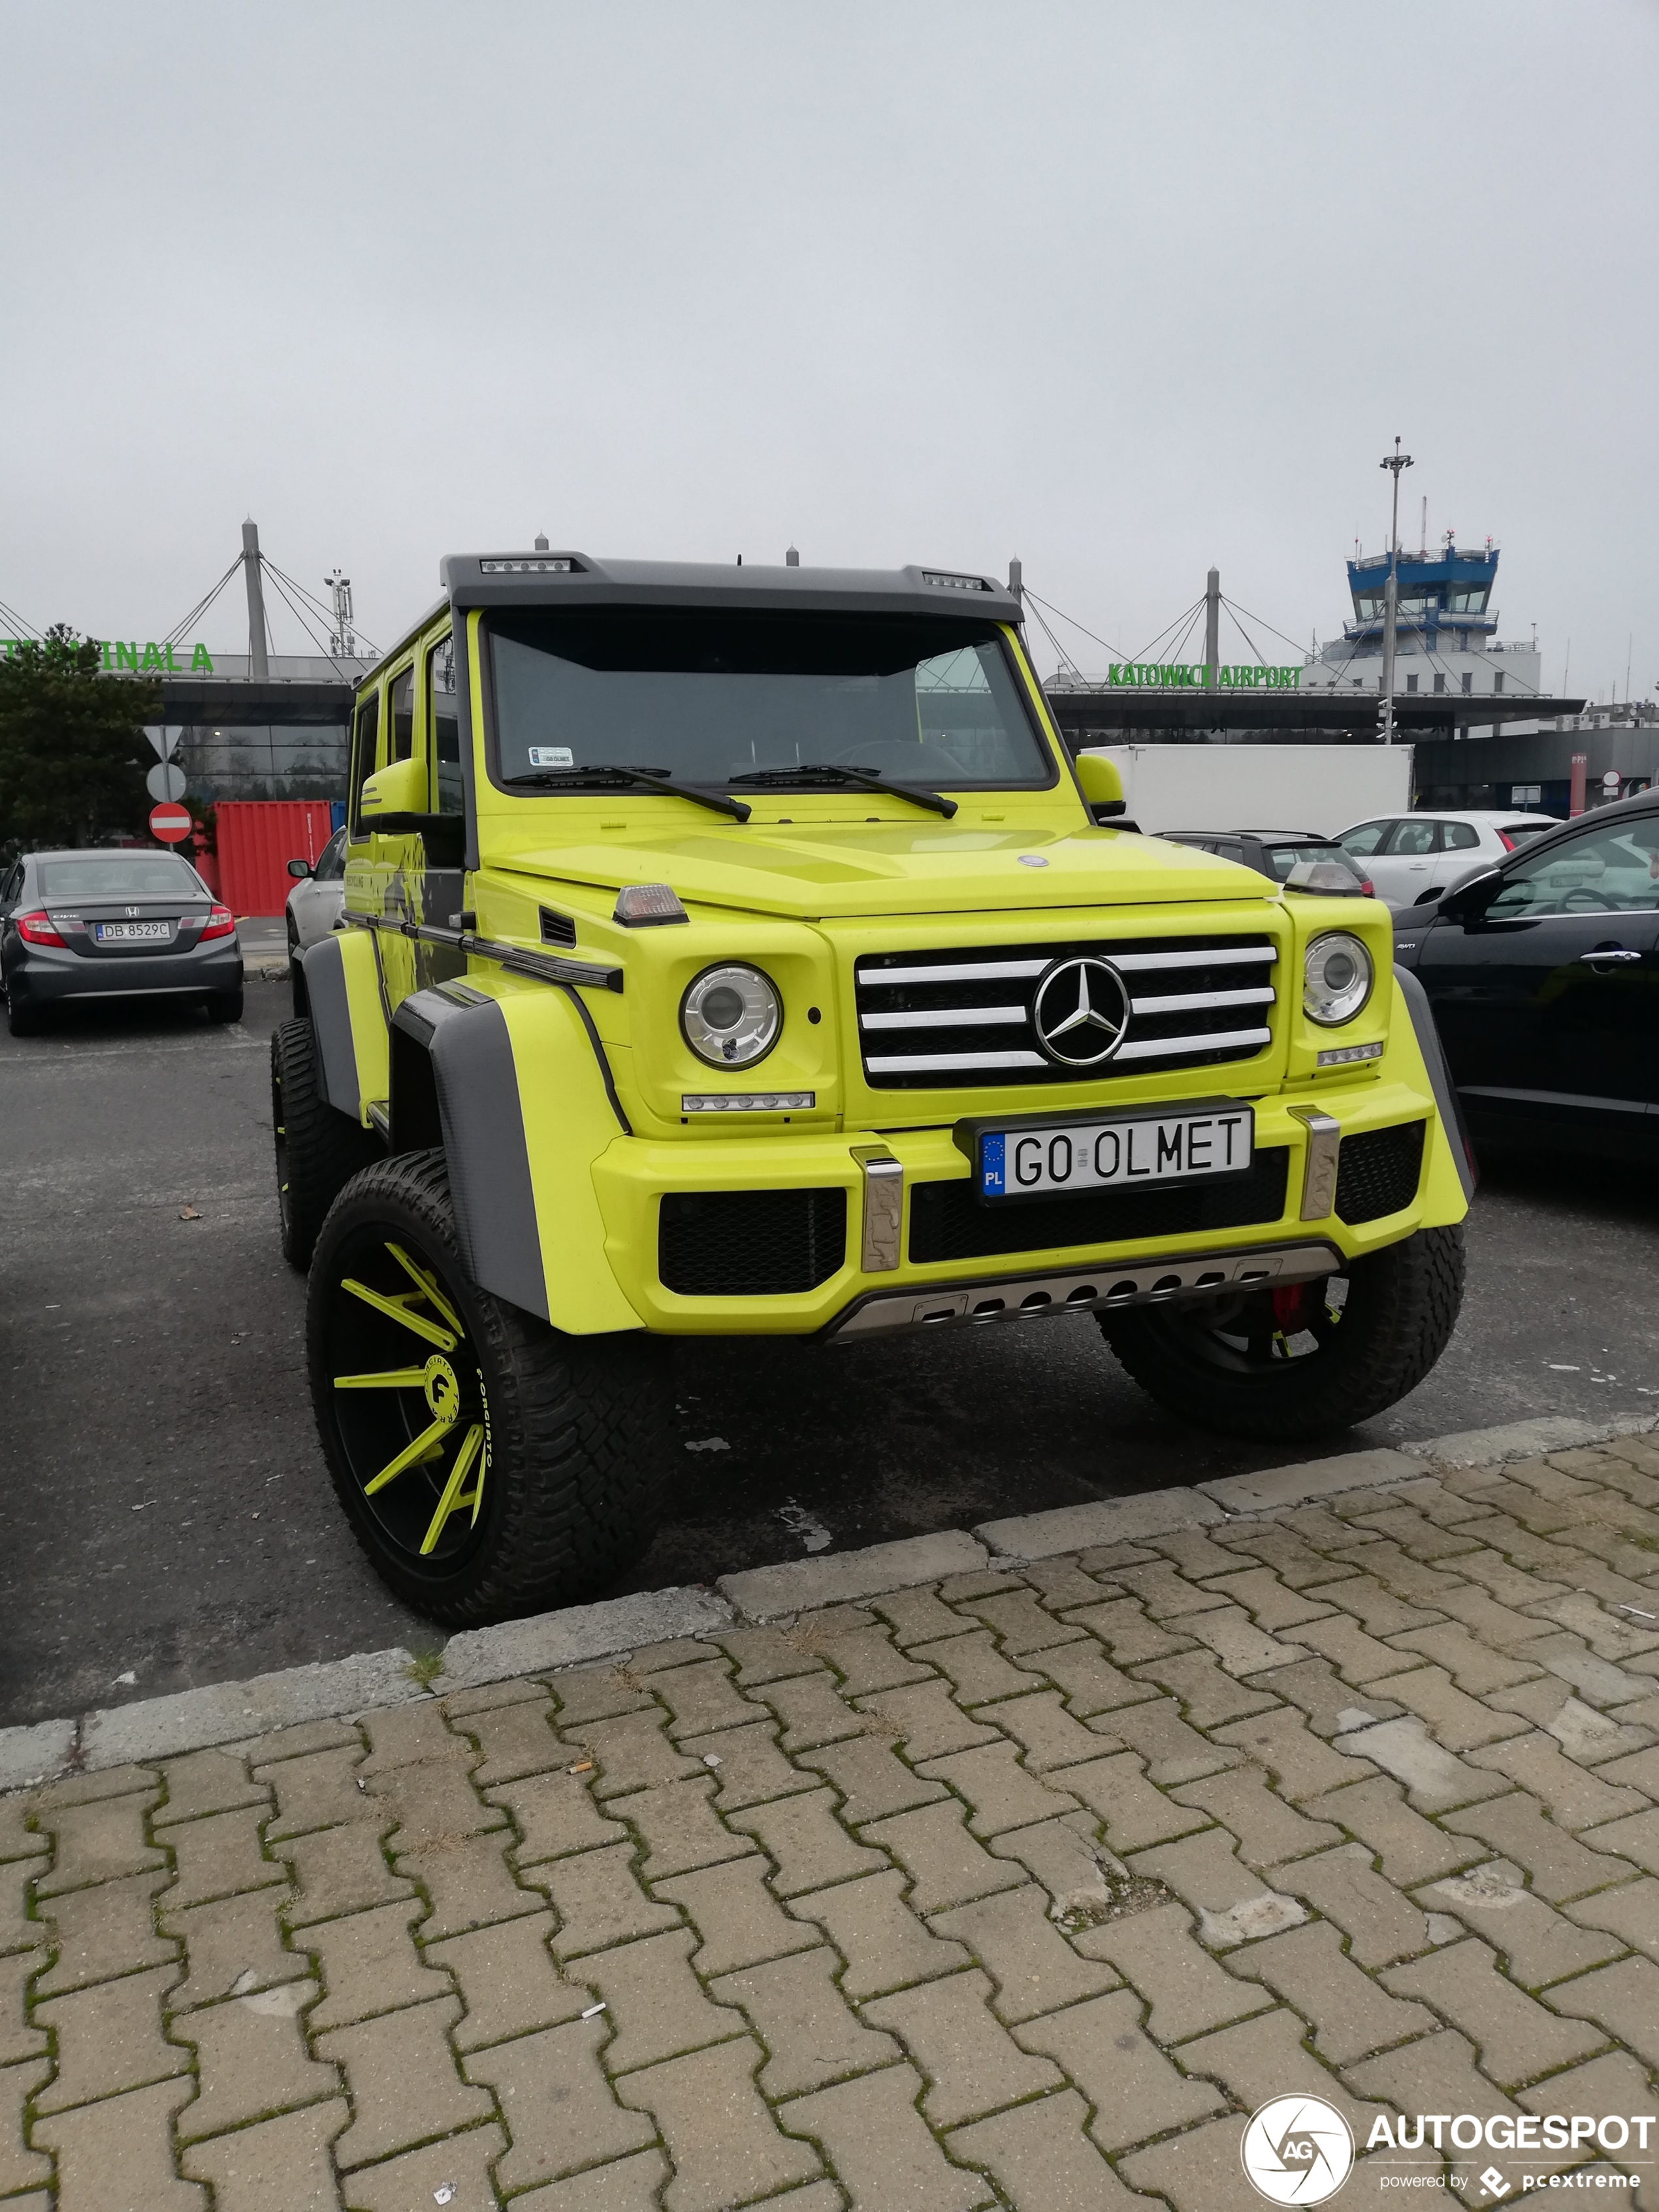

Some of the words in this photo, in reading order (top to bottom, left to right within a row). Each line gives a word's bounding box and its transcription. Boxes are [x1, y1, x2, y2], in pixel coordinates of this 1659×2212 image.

[0, 640, 182, 672] TINAL
[191, 643, 214, 672] A
[1109, 663, 1213, 687] KATOWICE
[1218, 665, 1304, 688] AIRPORT
[105, 925, 124, 937] DB
[129, 924, 168, 936] 8529C
[1094, 1117, 1242, 1178] OLMET
[985, 1171, 1003, 1186] PL
[476, 1368, 492, 1468] FORGIATO
